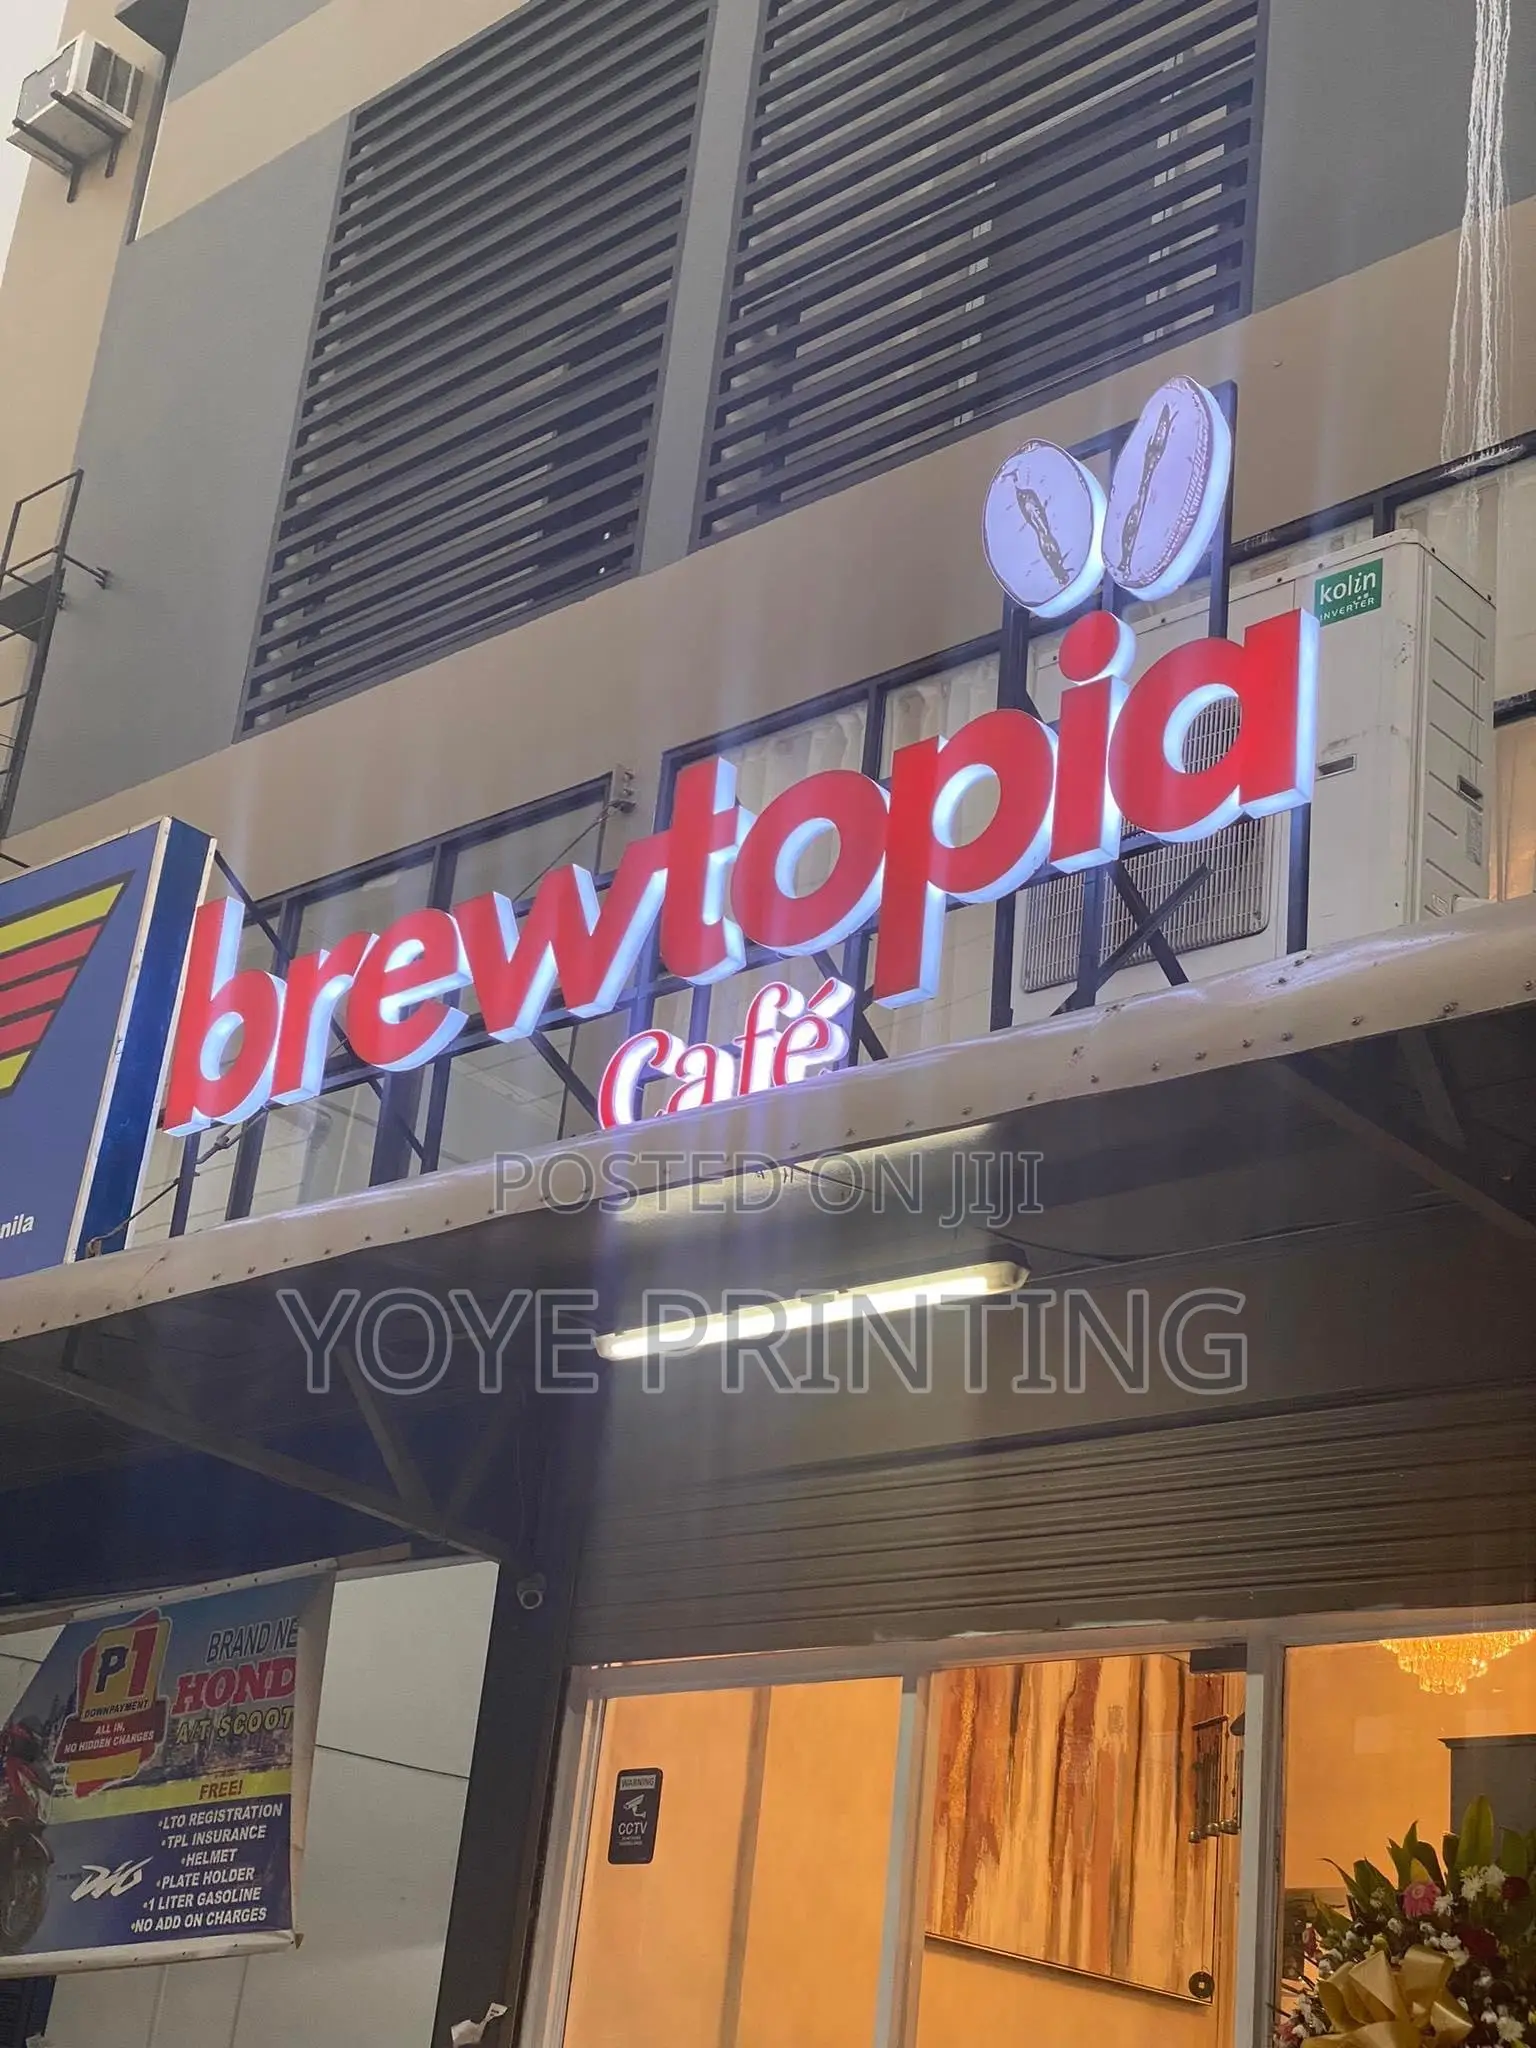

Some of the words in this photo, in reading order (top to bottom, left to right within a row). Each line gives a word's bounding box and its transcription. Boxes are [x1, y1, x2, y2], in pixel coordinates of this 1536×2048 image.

[1320, 572, 1376, 605] kolin
[164, 609, 1320, 1135] brewtopia
[206, 1622, 271, 1664] BRAND
[171, 1656, 297, 1716] HOND
[84, 1699, 149, 1718] DOWNPAYMENT
[94, 1724, 112, 1735] ALL
[217, 1706, 295, 1740] SCOOT
[63, 1743, 77, 1754] NO
[78, 1737, 112, 1752] HIDDEN
[113, 1730, 155, 1746] CHARGES
[200, 1780, 243, 1800] FREE!
[188, 1803, 283, 1826] REGISTRATION
[191, 1825, 267, 1846] INSURANCE
[618, 1821, 648, 1835] CCTV
[202, 1867, 255, 1885] HOLDER
[158, 1893, 197, 1910] LITER
[197, 1887, 262, 1907] GASOLINE
[154, 1914, 181, 1931] ADD
[184, 1912, 202, 1927] ON
[205, 1907, 268, 1926] CHARGES
